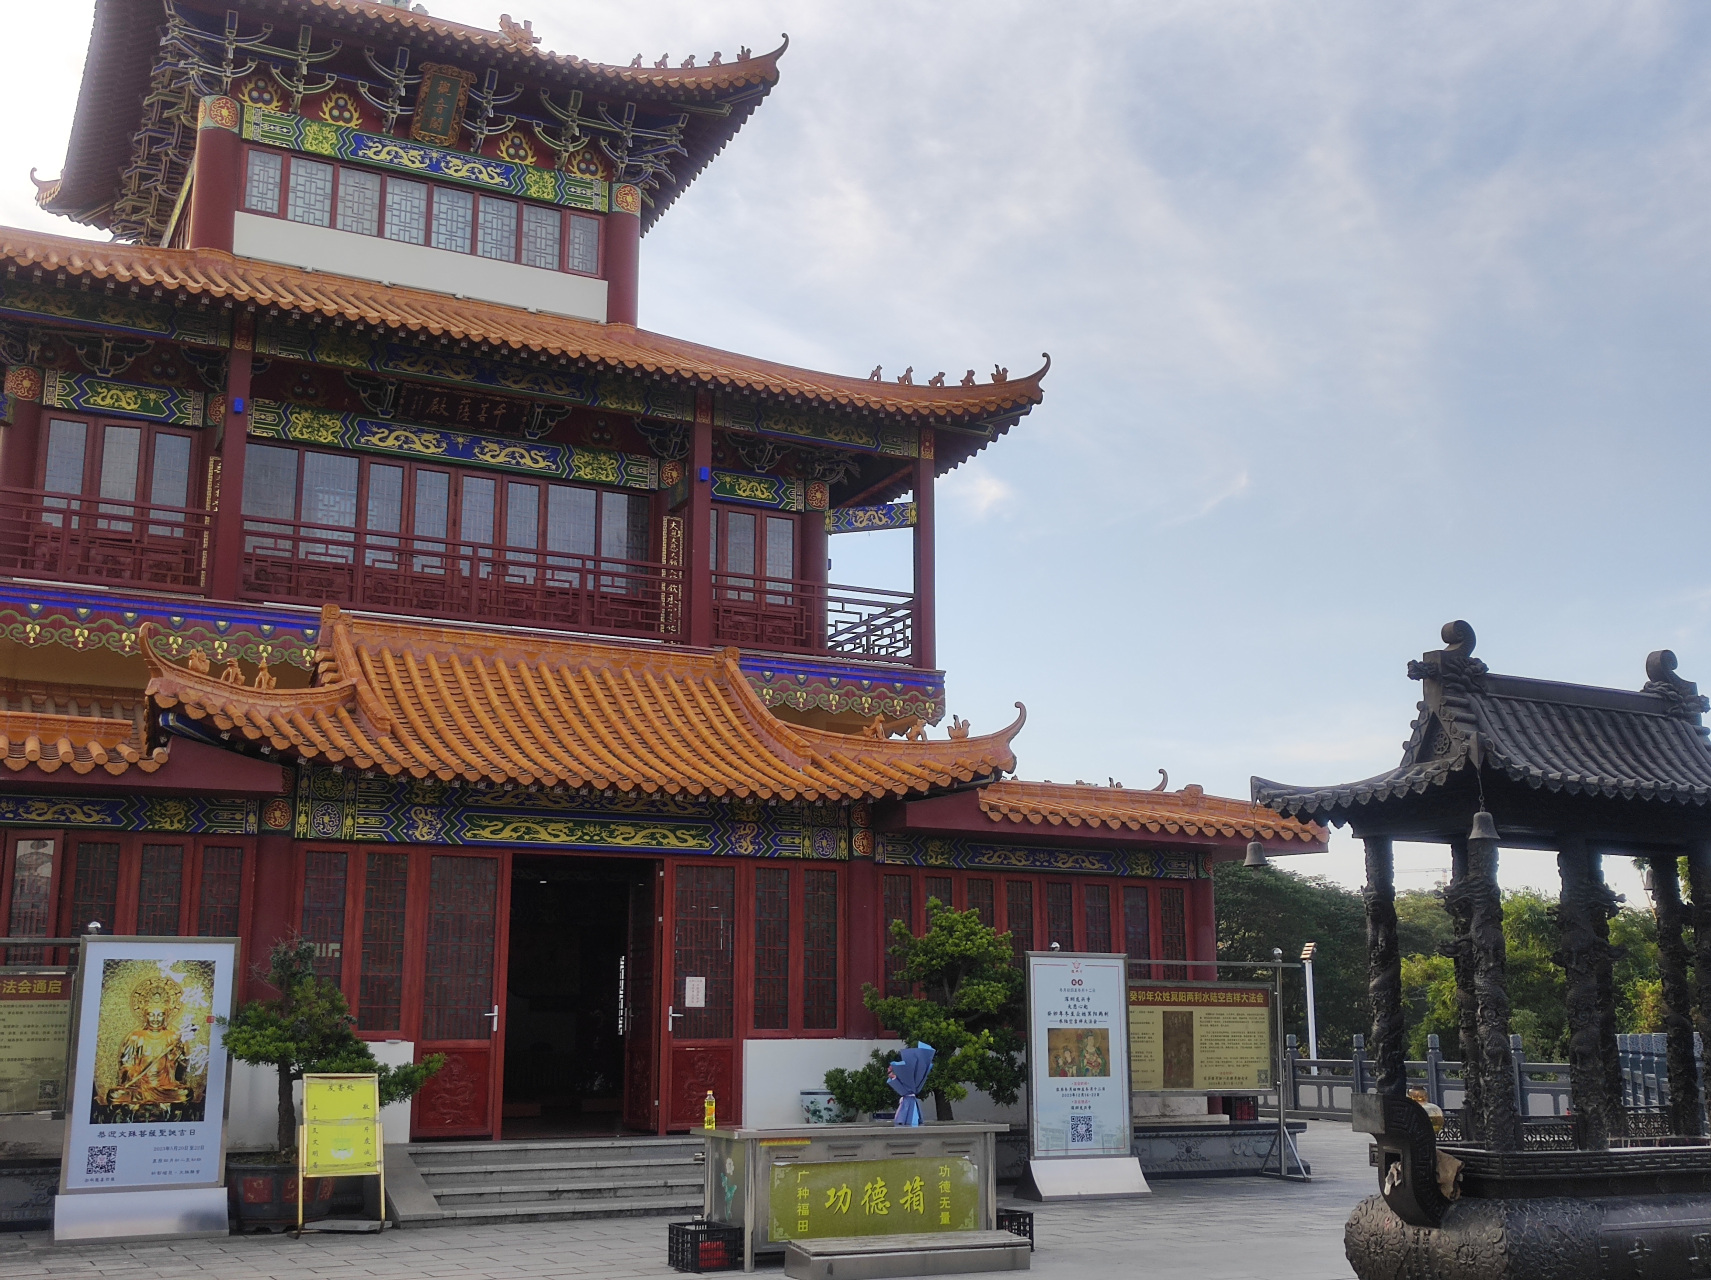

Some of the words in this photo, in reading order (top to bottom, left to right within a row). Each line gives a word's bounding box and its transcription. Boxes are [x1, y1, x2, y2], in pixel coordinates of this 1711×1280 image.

[0, 979, 62, 994] 法会通启
[1129, 991, 1265, 1004] 癸卯年众姓冥阳两利水陆空吉祥大法会
[97, 1129, 197, 1139] 恭迎文殊菩薩聖誕吉日
[797, 1170, 810, 1232] 广种福田
[824, 1176, 926, 1216] 功德箱
[938, 1165, 951, 1225] 功德无量
